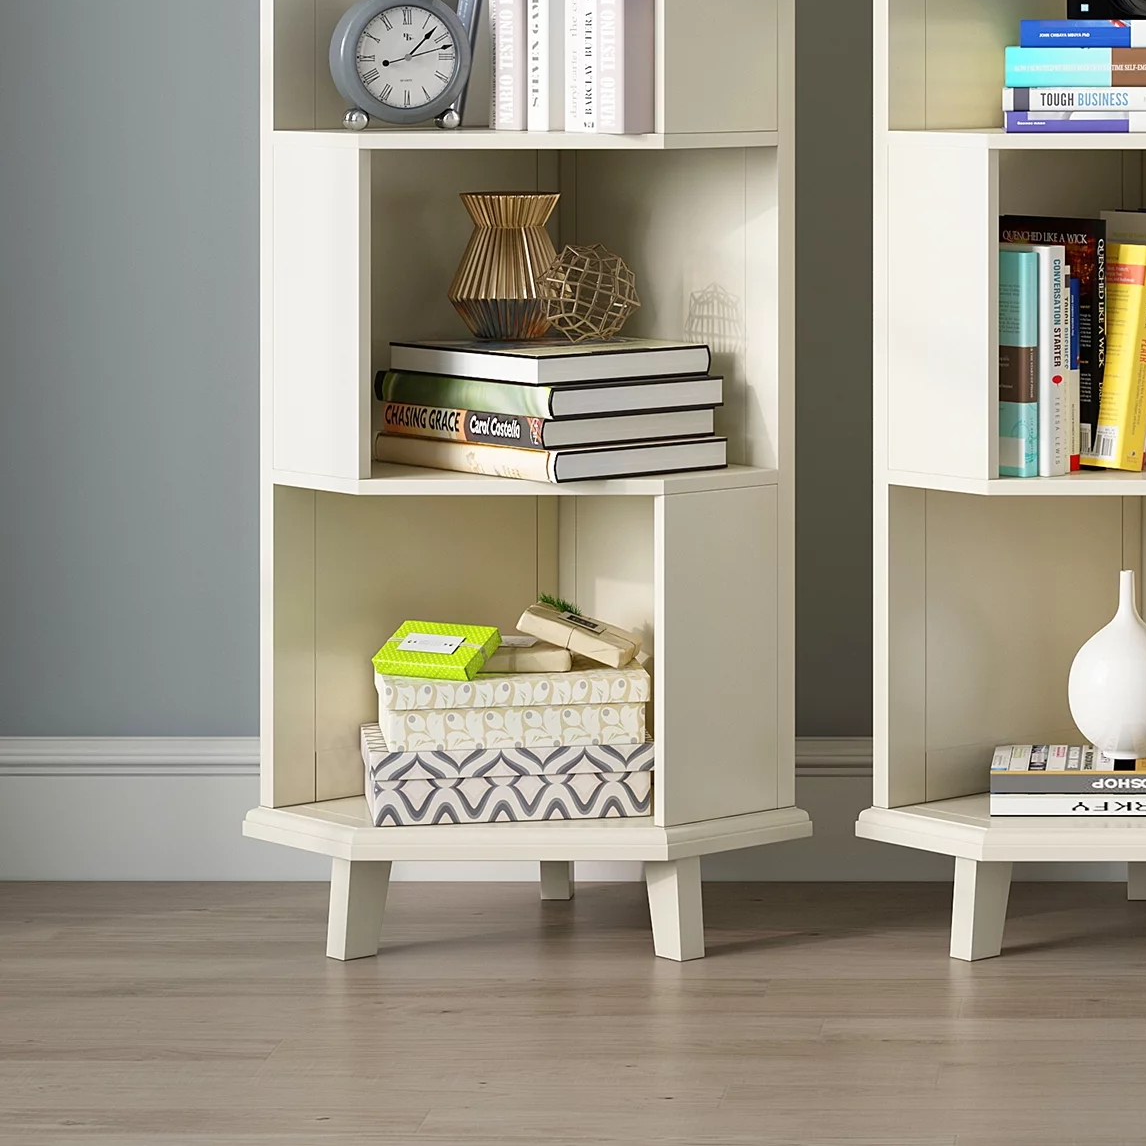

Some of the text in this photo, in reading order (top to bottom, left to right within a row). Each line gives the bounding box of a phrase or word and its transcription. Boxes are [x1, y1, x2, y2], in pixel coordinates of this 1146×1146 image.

[499, 9, 514, 69] TESTINO
[569, 16, 578, 37] the
[584, 11, 593, 57] BUTERA
[601, 10, 616, 71] TESTINO
[499, 75, 514, 124] MARIO
[584, 63, 593, 115] BARCLAY
[601, 76, 616, 127] MARIO
[1040, 92, 1128, 106] TOUGH BUSINESS
[1002, 230, 1087, 244] QUENCHED LIKE A WICK
[1097, 239, 1105, 299] QUENCHED
[1053, 259, 1062, 367] CONVERSATION STARTER
[1098, 326, 1105, 334] A
[385, 405, 426, 429] CHASING
[429, 410, 461, 432] GRACE
[469, 414, 490, 435] Carol
[490, 418, 521, 439] Costello
